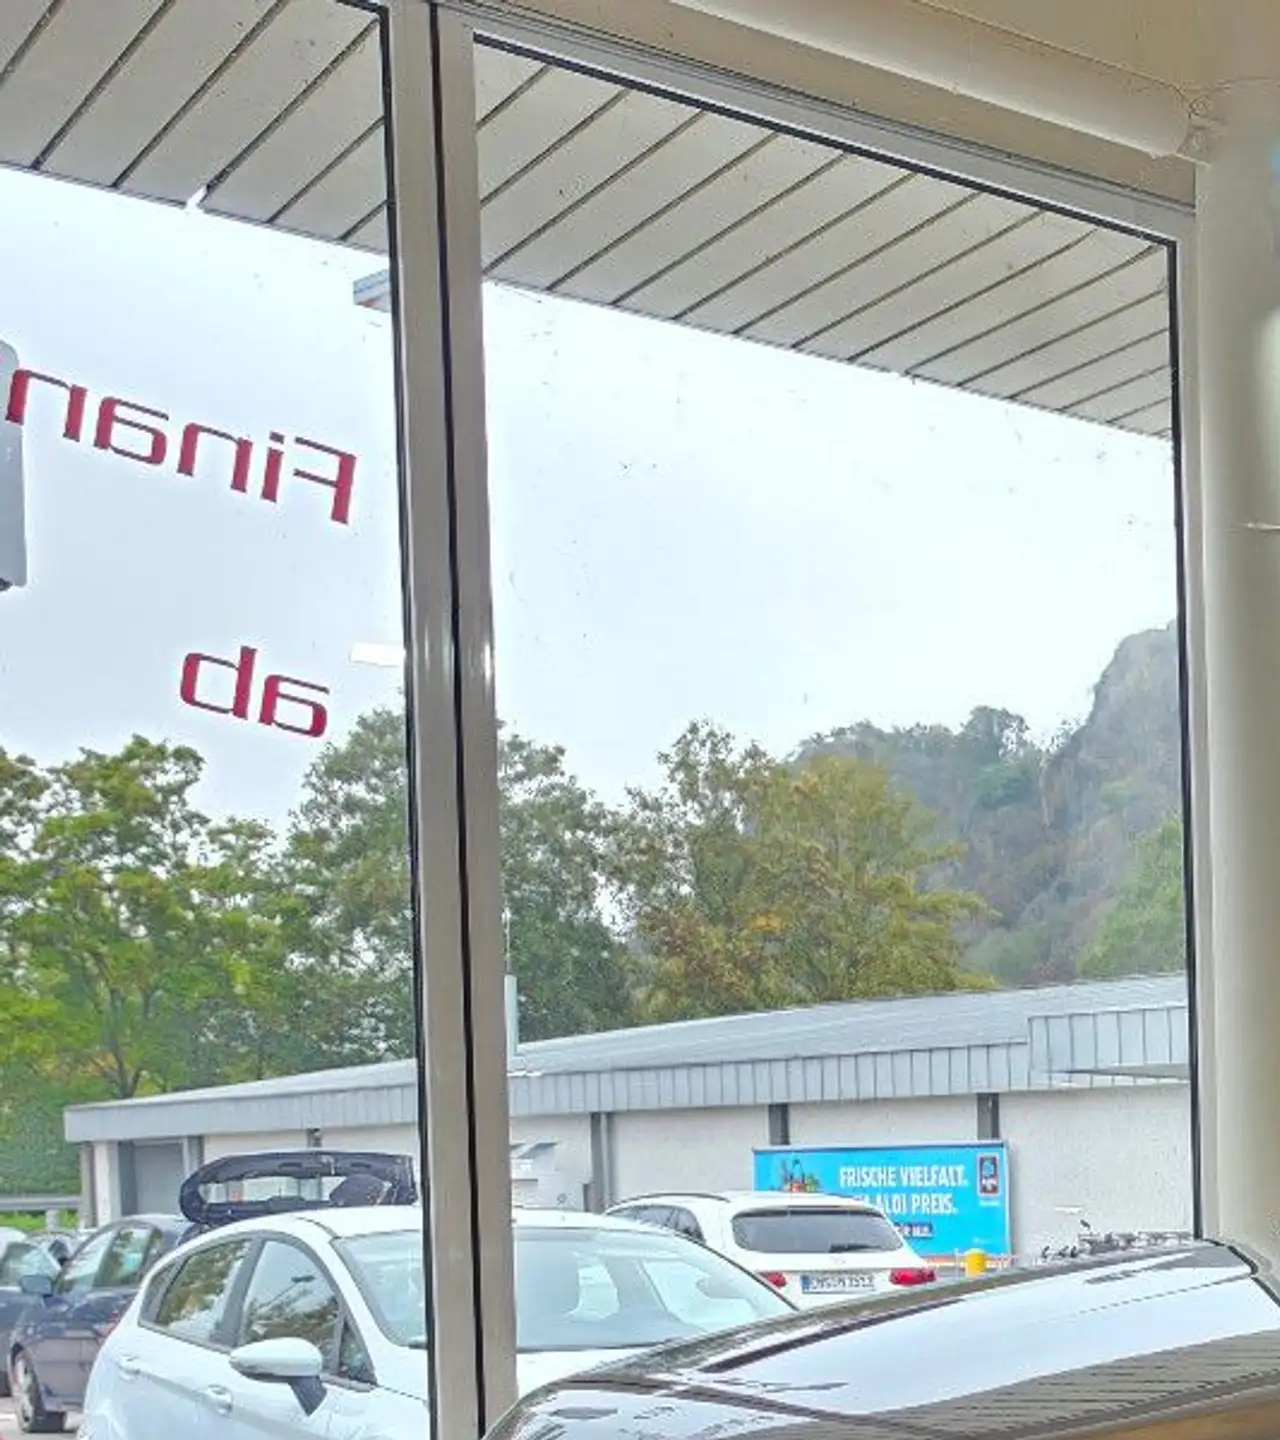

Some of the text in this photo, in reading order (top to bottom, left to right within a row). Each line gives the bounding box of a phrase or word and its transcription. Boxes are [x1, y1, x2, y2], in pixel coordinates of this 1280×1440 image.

[839, 1163, 968, 1189] FRISCHE VIELFALT.
[911, 1192, 958, 1215] PREIS.
